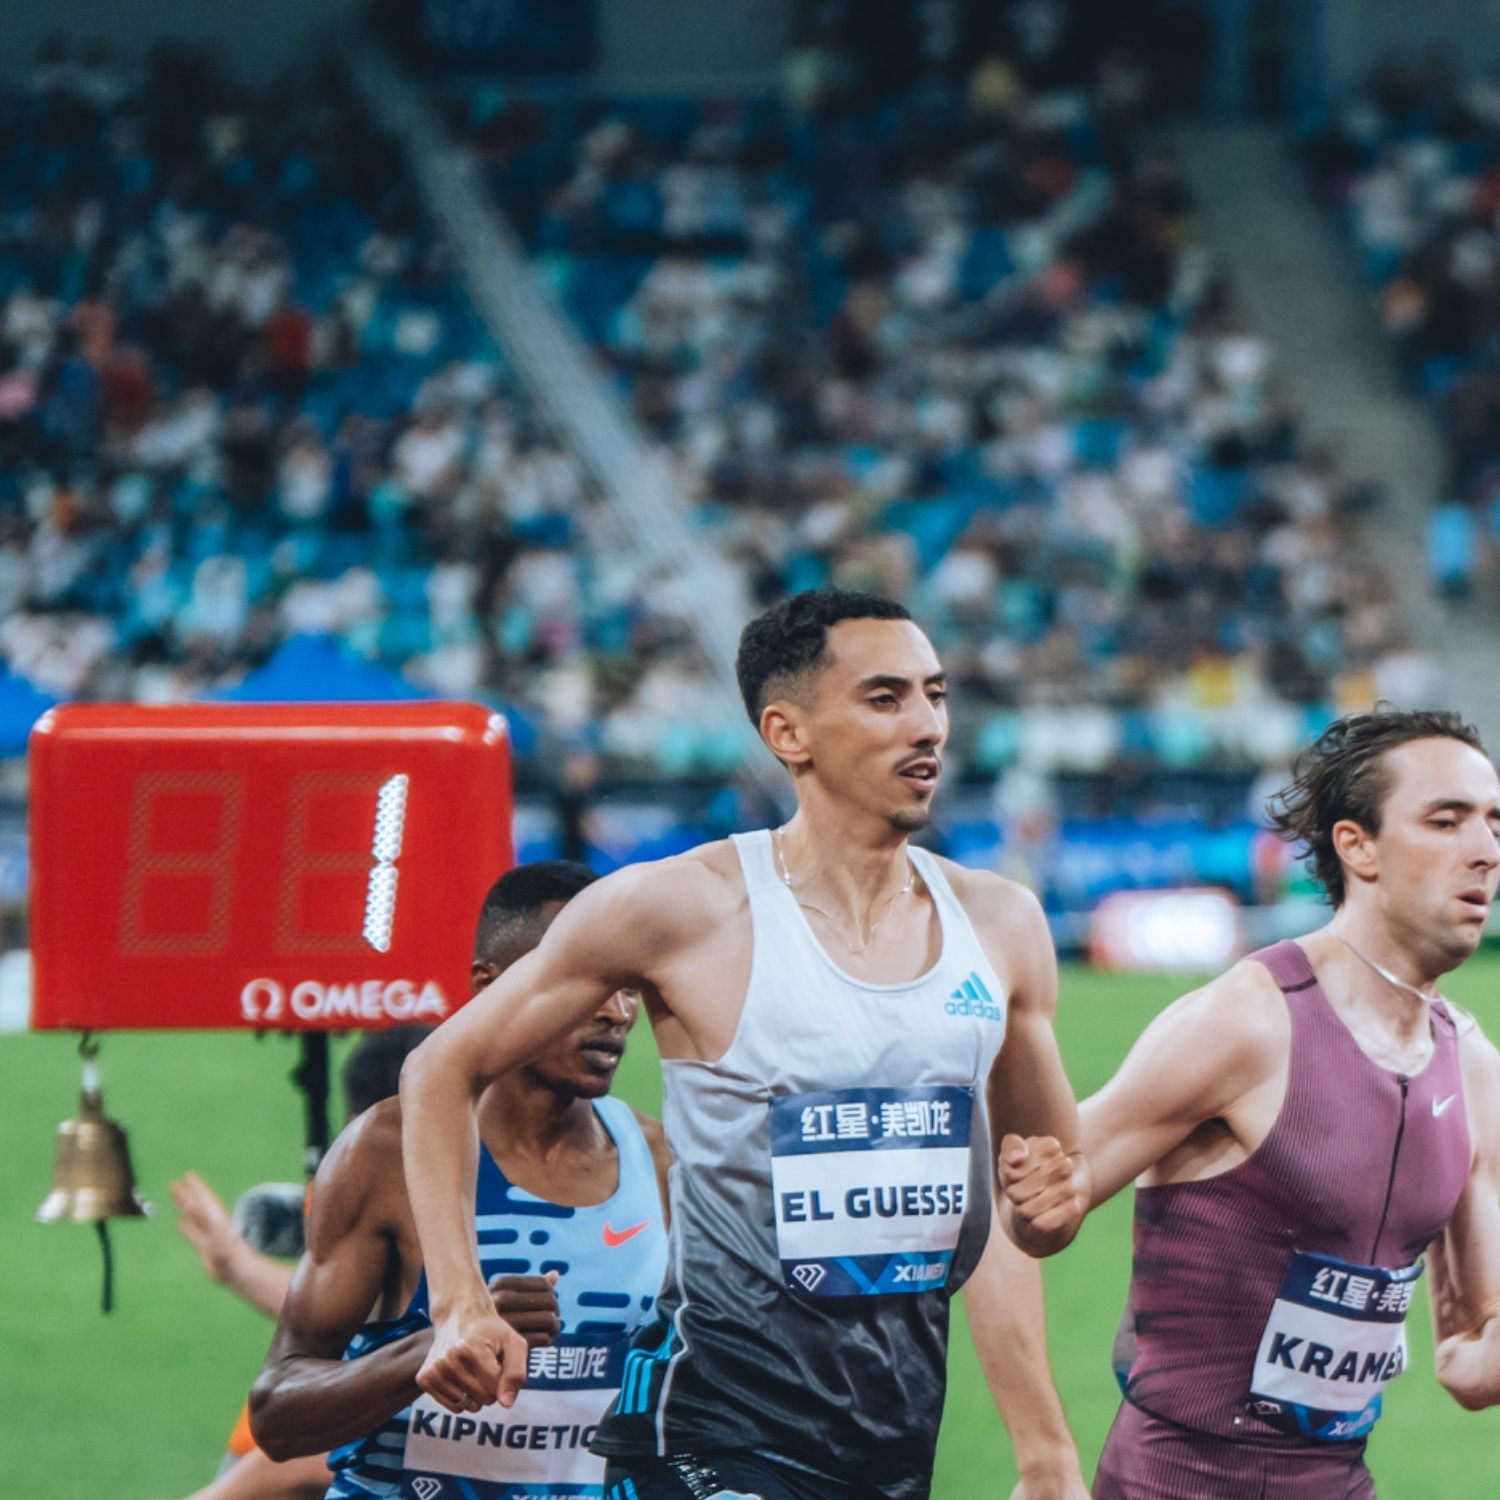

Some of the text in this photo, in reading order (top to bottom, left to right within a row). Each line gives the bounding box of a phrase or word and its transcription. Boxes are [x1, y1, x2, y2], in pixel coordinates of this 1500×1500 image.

[290, 979, 447, 1021] OMEGA
[944, 999, 1001, 1022] adidas
[800, 1101, 951, 1142] 红星·美凯龙
[780, 1184, 964, 1223] EL GUESSE
[528, 1345, 609, 1379] 美凯龙
